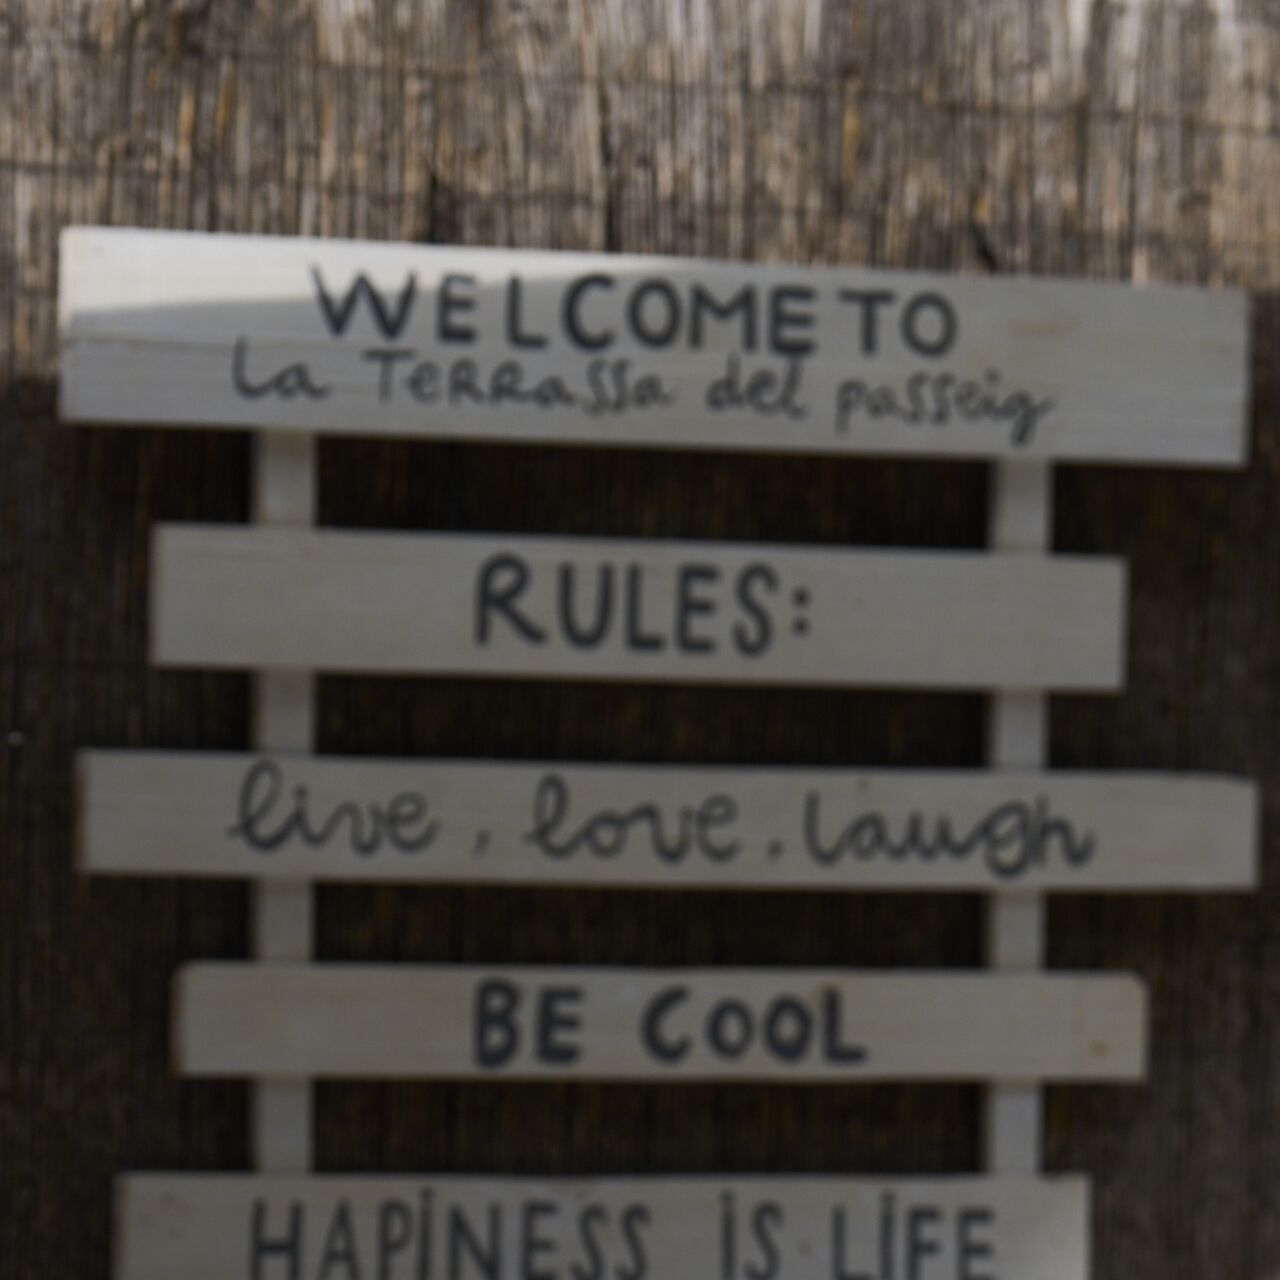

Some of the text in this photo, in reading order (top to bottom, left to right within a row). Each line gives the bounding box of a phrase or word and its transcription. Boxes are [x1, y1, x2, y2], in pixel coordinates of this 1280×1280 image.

[311, 265, 959, 359] WELCOME TO
[705, 354, 810, 421] del
[473, 551, 812, 659] RULES:
[475, 979, 870, 1069] BE COOL
